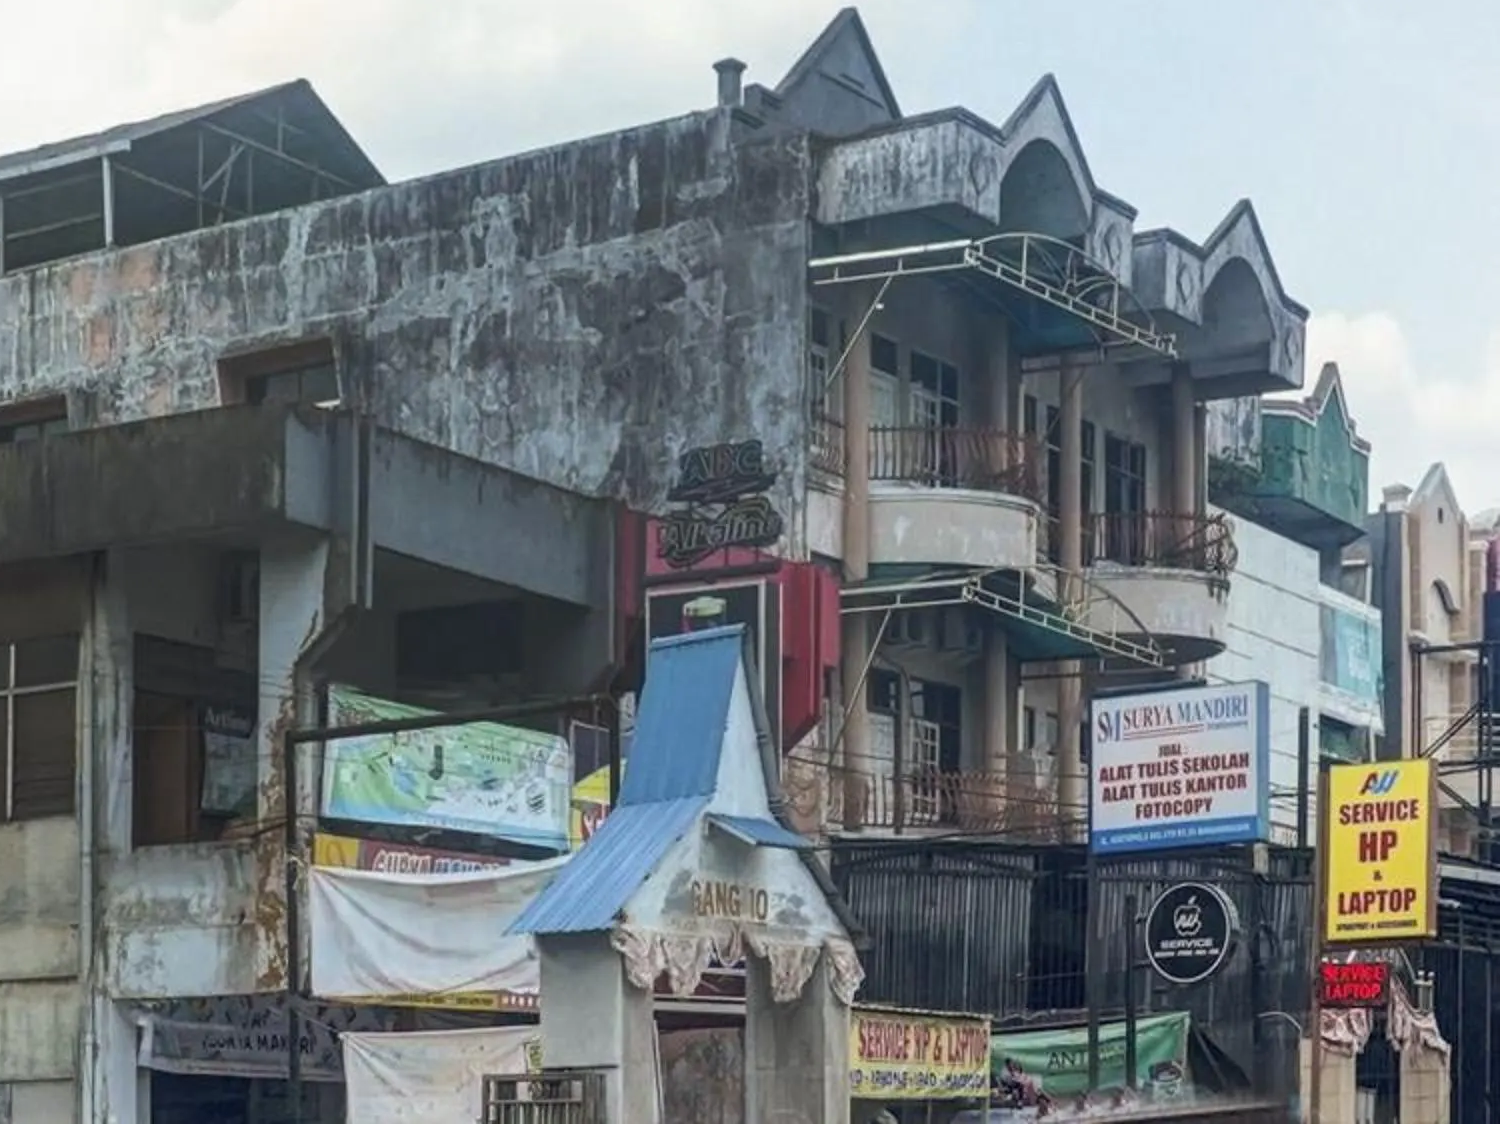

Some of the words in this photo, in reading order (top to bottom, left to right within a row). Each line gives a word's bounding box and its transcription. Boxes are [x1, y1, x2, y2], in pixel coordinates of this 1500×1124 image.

[1123, 705, 1174, 730] SURYA
[1177, 694, 1248, 723] MANDIRI
[1100, 764, 1133, 782] ALAT
[1137, 759, 1179, 778] TULIS
[1182, 752, 1249, 774] SEKOLAH
[1102, 785, 1136, 803] ALAT
[1140, 780, 1182, 798] TULIS
[1185, 774, 1247, 794] KANTOR
[1135, 798, 1212, 820] FOTOCOPY
[1339, 799, 1419, 825] SERVICE
[1359, 831, 1397, 863] HP
[692, 880, 740, 916] GANG
[750, 888, 768, 921] 10
[1338, 888, 1417, 915] LAPTOP
[858, 1018, 909, 1059] SERVICE
